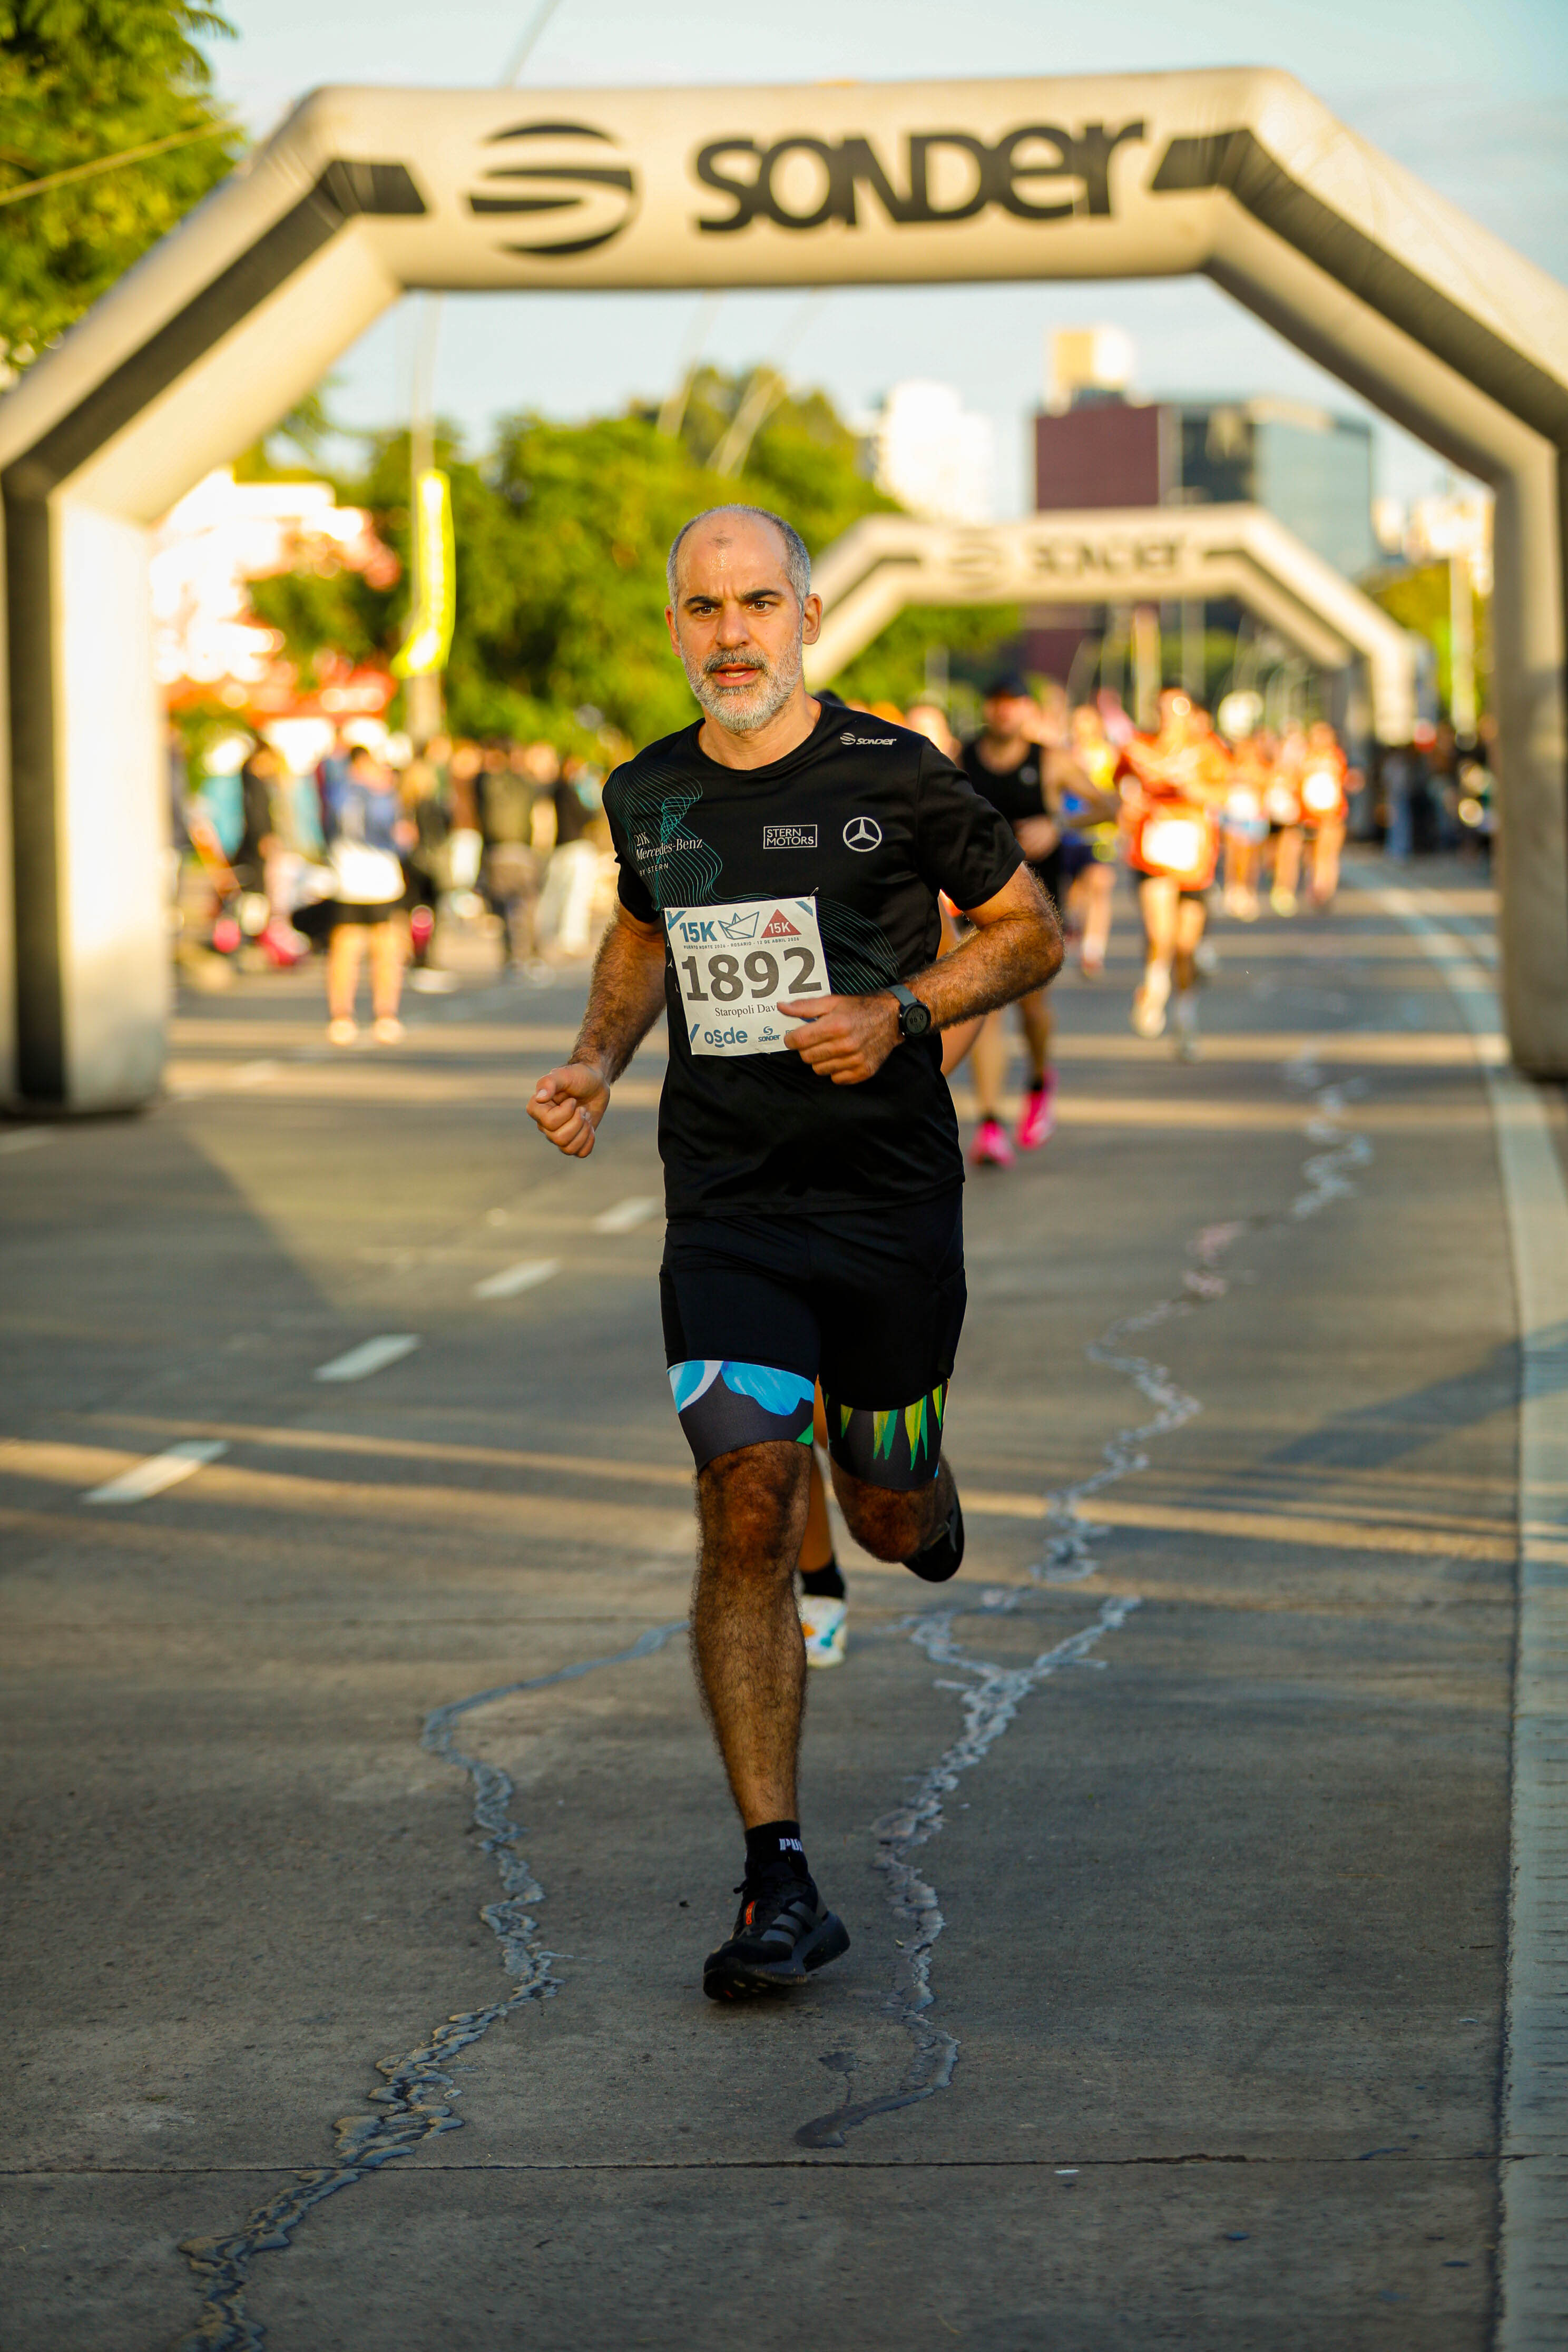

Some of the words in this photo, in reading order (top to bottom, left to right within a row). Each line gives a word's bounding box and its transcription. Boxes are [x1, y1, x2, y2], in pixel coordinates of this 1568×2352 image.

[634, 832, 650, 846] 21K
[767, 828, 801, 838] STERN
[767, 836, 814, 846] MOTORS
[636, 839, 702, 861] Mercedes-Benz
[648, 863, 669, 873] STERN
[679, 921, 718, 943] 15K
[769, 922, 791, 934] 15K
[681, 947, 822, 1002] 1892
[715, 1005, 754, 1017] Staropoli
[757, 1004, 776, 1013] Dav
[704, 1026, 748, 1047] osde
[779, 1838, 802, 1851] PU
